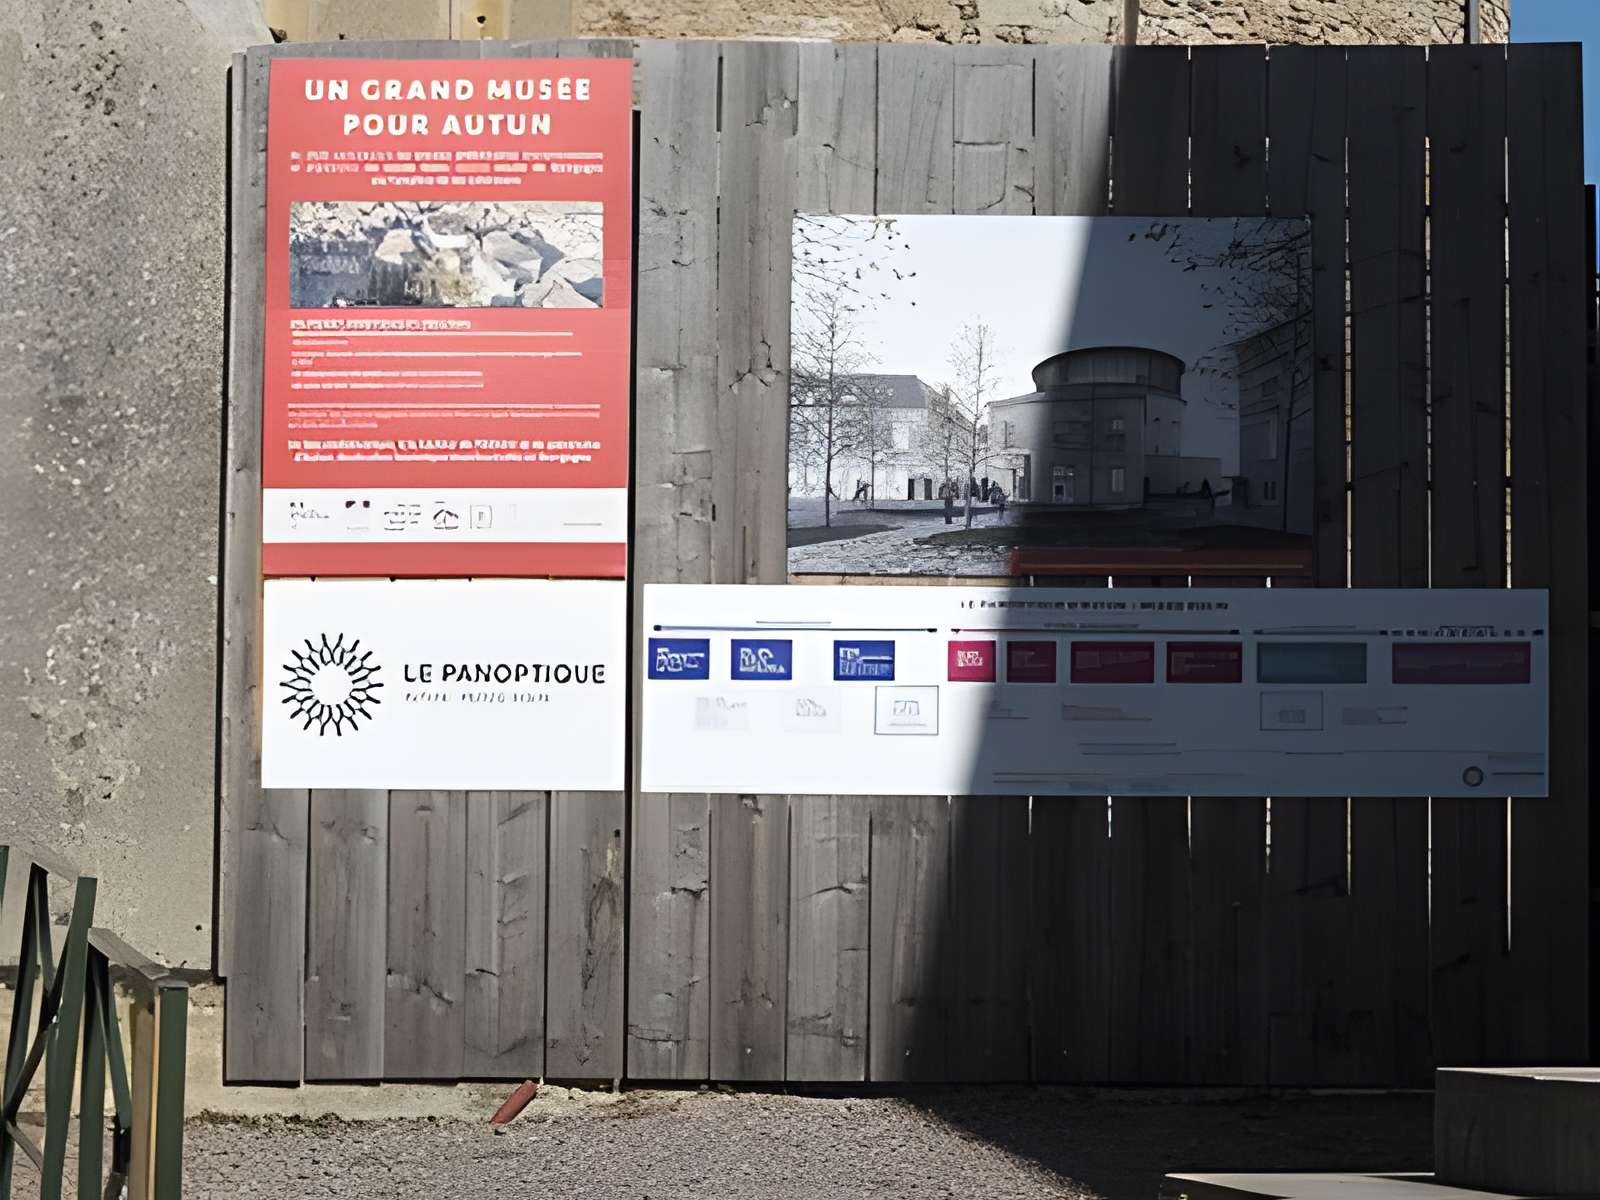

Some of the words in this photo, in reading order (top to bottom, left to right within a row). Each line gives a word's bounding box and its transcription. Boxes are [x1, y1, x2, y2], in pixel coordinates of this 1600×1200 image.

[304, 79, 349, 101] UN
[360, 78, 474, 101] GRAND
[343, 113, 429, 136] POUR
[441, 113, 551, 136] AUTUN
[404, 663, 433, 684] LE
